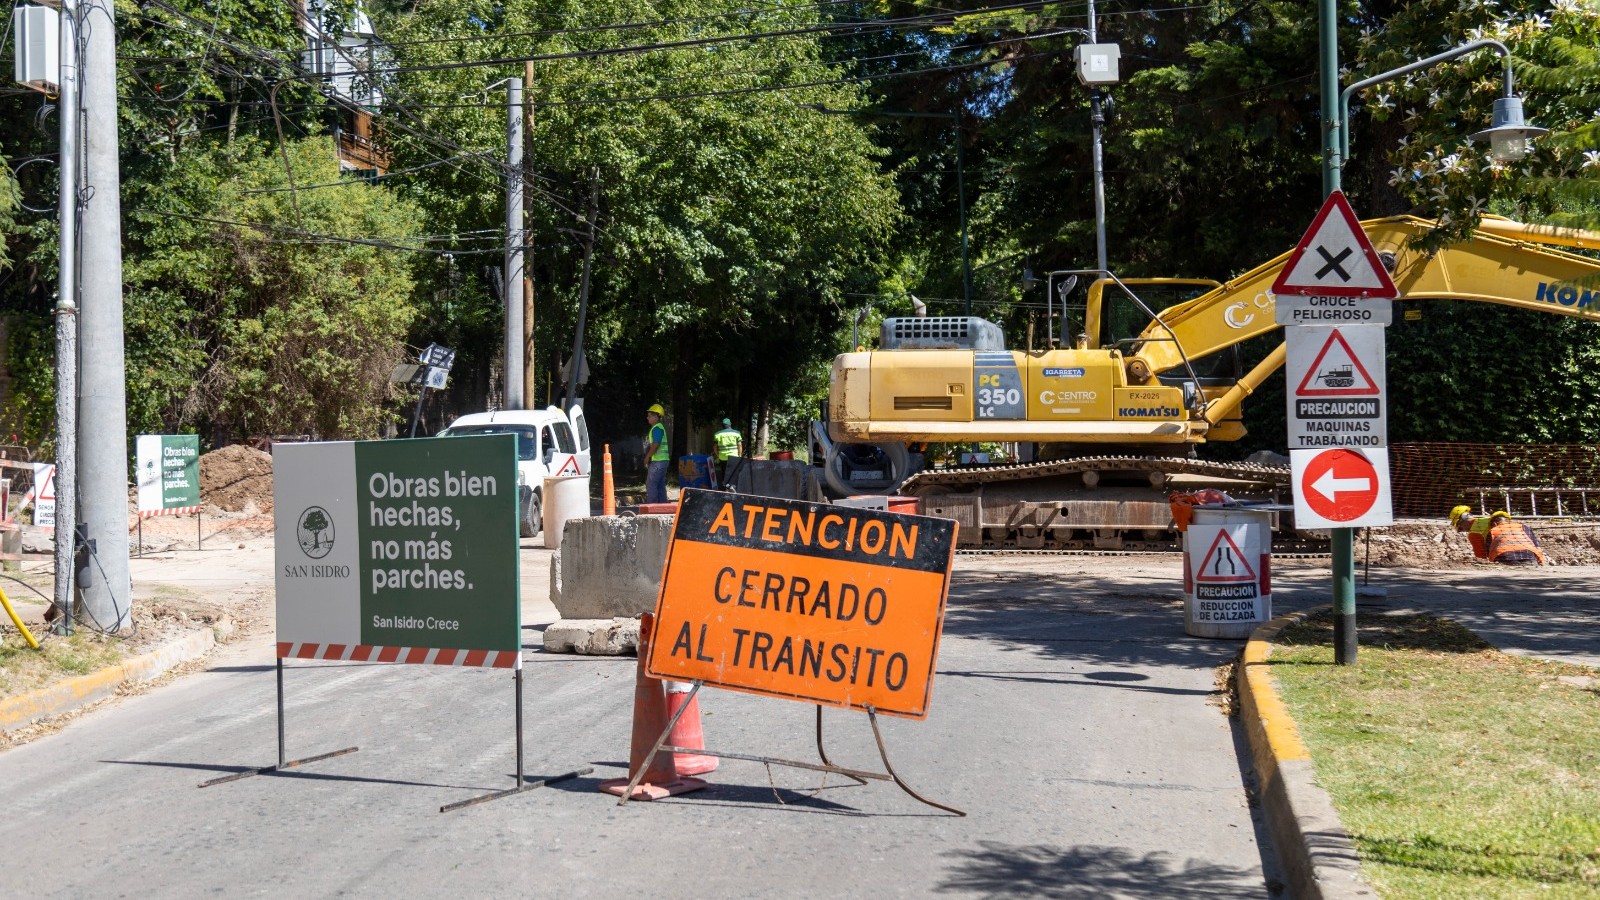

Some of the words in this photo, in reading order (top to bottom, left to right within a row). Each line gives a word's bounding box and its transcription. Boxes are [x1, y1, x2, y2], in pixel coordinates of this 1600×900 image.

[1310, 296, 1356, 306] CRUCE
[1293, 309, 1372, 320] PELIGROSO
[979, 374, 1000, 387] PC
[978, 388, 1020, 405] 350
[1057, 391, 1097, 400] CENTRO
[979, 406, 995, 417] LC
[1118, 405, 1180, 417] KOMATSU
[1300, 402, 1376, 415] PRECAUCION
[1306, 421, 1371, 432] MAQUINAS
[1298, 435, 1379, 446] TRABAJANDO
[164, 447, 181, 457] Obras
[181, 447, 196, 456] bien
[163, 457, 187, 468] hechas,
[164, 470, 172, 478] no
[172, 468, 185, 478] más
[164, 479, 190, 490] parches.
[369, 472, 440, 498] Obras
[444, 470, 497, 497] bien
[370, 500, 461, 531] hechas,
[708, 502, 919, 560] ATENCION
[371, 540, 400, 560] no
[404, 531, 453, 560] más
[284, 565, 308, 578] SAN
[311, 565, 350, 578] ISIDRO
[372, 562, 474, 594] parches.
[714, 566, 887, 626] CERRADO
[1199, 586, 1254, 597] PRECAUCION
[1200, 601, 1254, 611] REDUCCION
[1200, 611, 1211, 620] DE
[1213, 611, 1256, 620] CALZADA
[373, 615, 393, 628] San
[394, 615, 425, 629] Isidro
[426, 616, 460, 630] Crece
[671, 621, 714, 663] AL
[732, 628, 908, 692] TRANSITO
